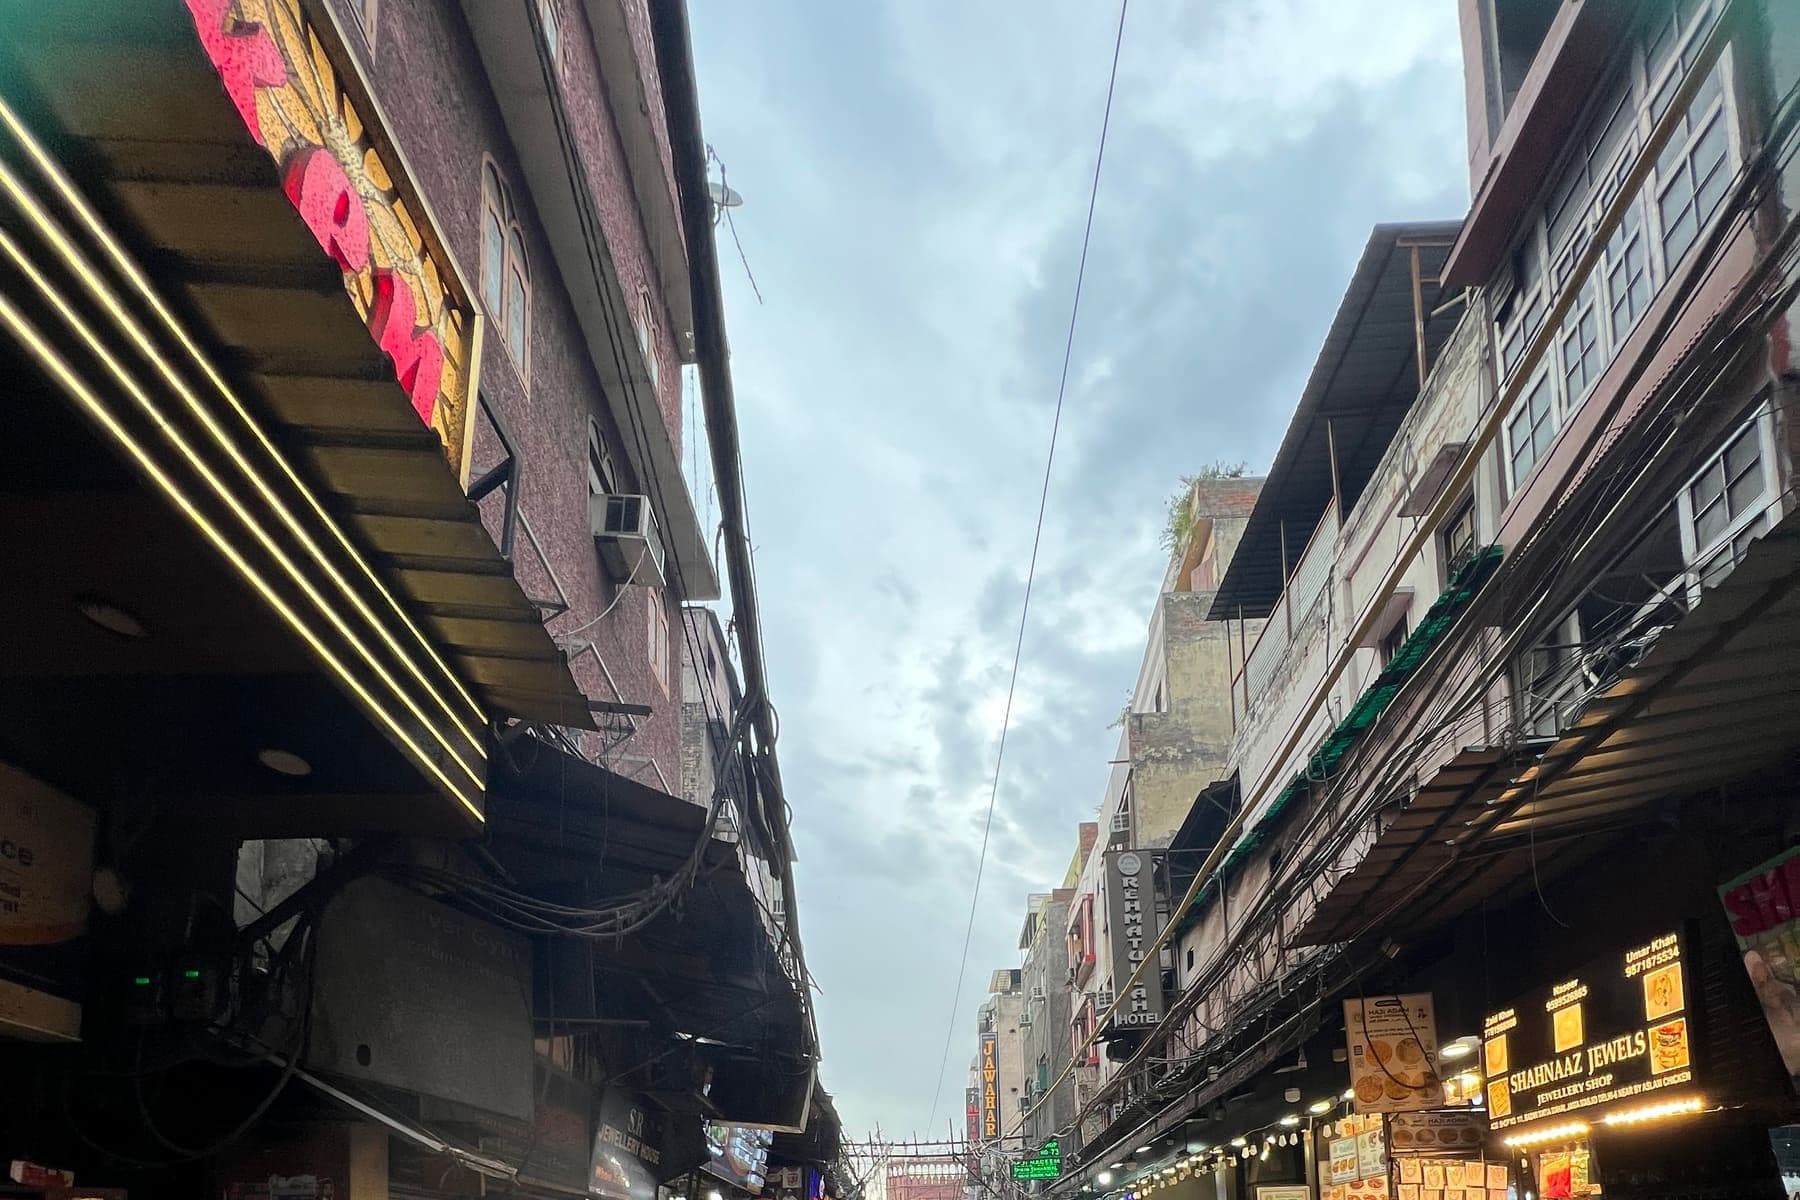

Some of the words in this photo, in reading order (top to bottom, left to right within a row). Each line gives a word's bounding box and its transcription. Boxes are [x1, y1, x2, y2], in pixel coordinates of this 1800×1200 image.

[1626, 945, 1650, 964] Umar
[1651, 933, 1677, 953] Khan
[1118, 1012, 1161, 1025] HOTEL
[1510, 1052, 1583, 1094] SHAHNAAZ
[1587, 1031, 1647, 1076] JEWELS
[983, 1040, 996, 1136] JAWAHAR
[1537, 1080, 1584, 1106] JEWELLERY
[1585, 1074, 1613, 1093] SHOP
